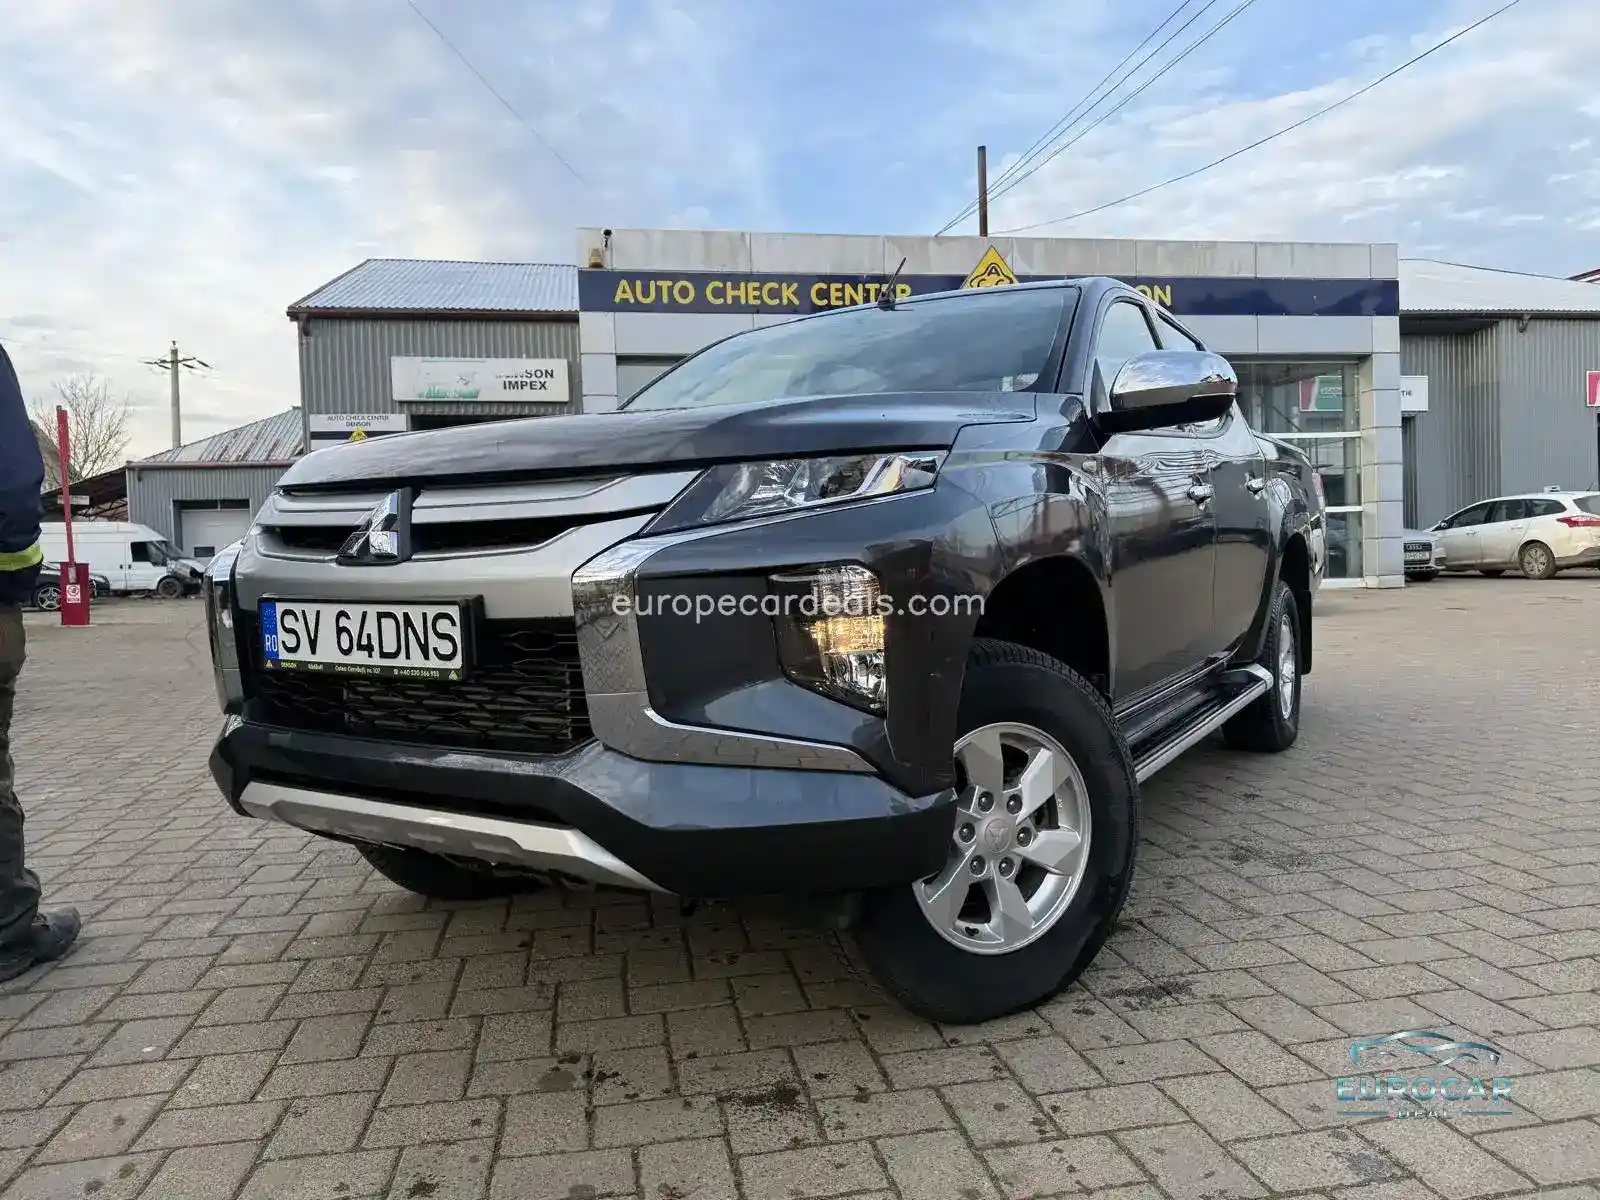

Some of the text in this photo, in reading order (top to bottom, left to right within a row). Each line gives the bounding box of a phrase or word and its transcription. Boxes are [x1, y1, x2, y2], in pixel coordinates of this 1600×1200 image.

[614, 278, 696, 305] AUTO
[705, 280, 800, 306] CHECK
[503, 380, 547, 390] IMPEX
[265, 608, 458, 662] RO SV 64DNS
